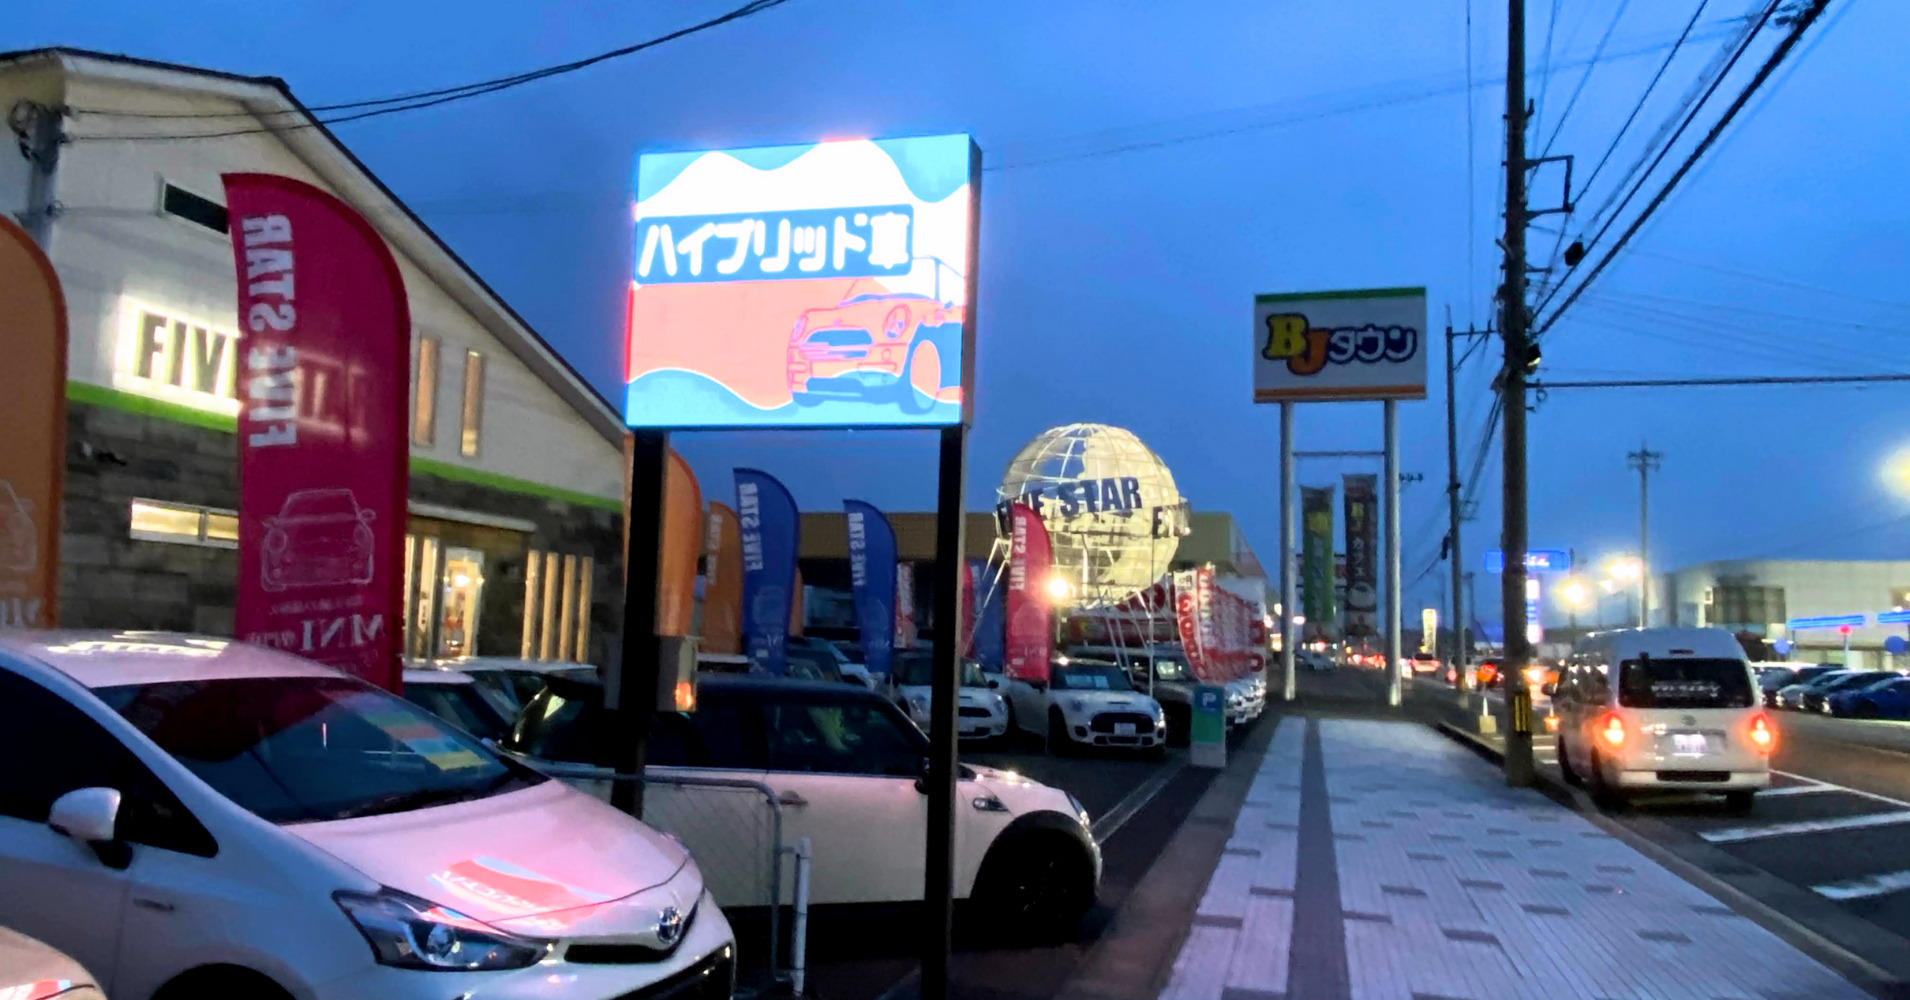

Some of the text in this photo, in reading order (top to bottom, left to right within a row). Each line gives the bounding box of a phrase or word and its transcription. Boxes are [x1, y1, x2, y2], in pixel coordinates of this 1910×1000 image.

[638, 212, 910, 276] ハイブリッド車
[134, 308, 237, 397] FIV
[1057, 477, 1142, 517] STAR
[1202, 692, 1217, 708] P
